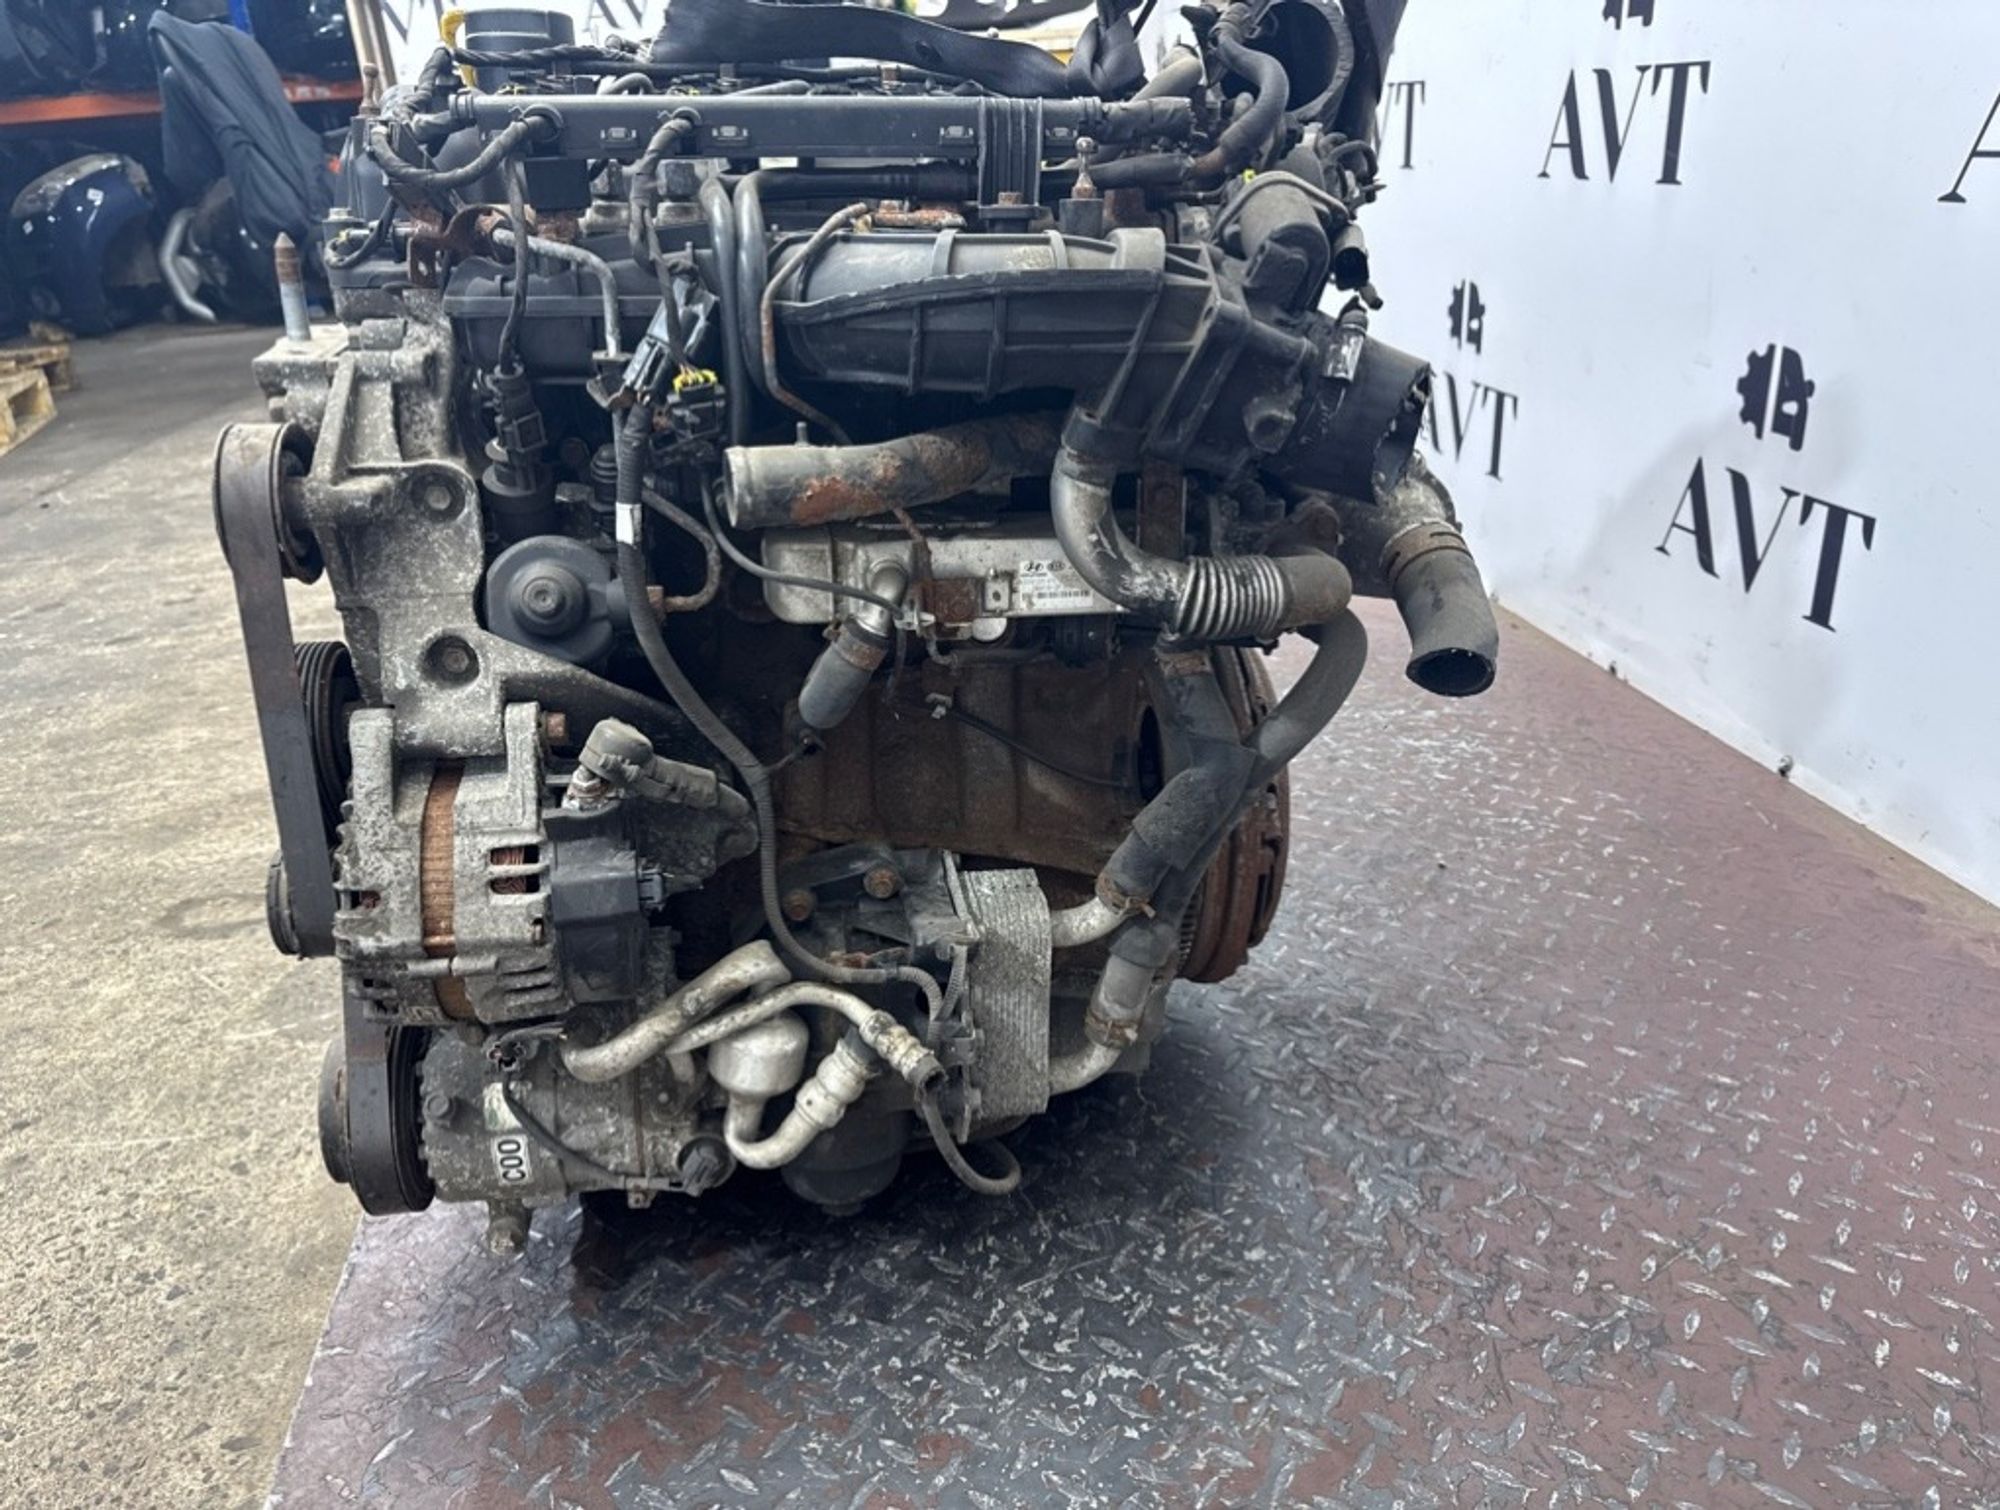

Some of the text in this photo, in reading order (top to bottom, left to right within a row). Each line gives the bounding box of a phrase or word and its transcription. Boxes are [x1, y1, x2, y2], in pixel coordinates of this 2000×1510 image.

[1374, 80, 1426, 170] VT
[1537, 60, 1711, 186] AVT
[1654, 456, 1877, 633] AVT
